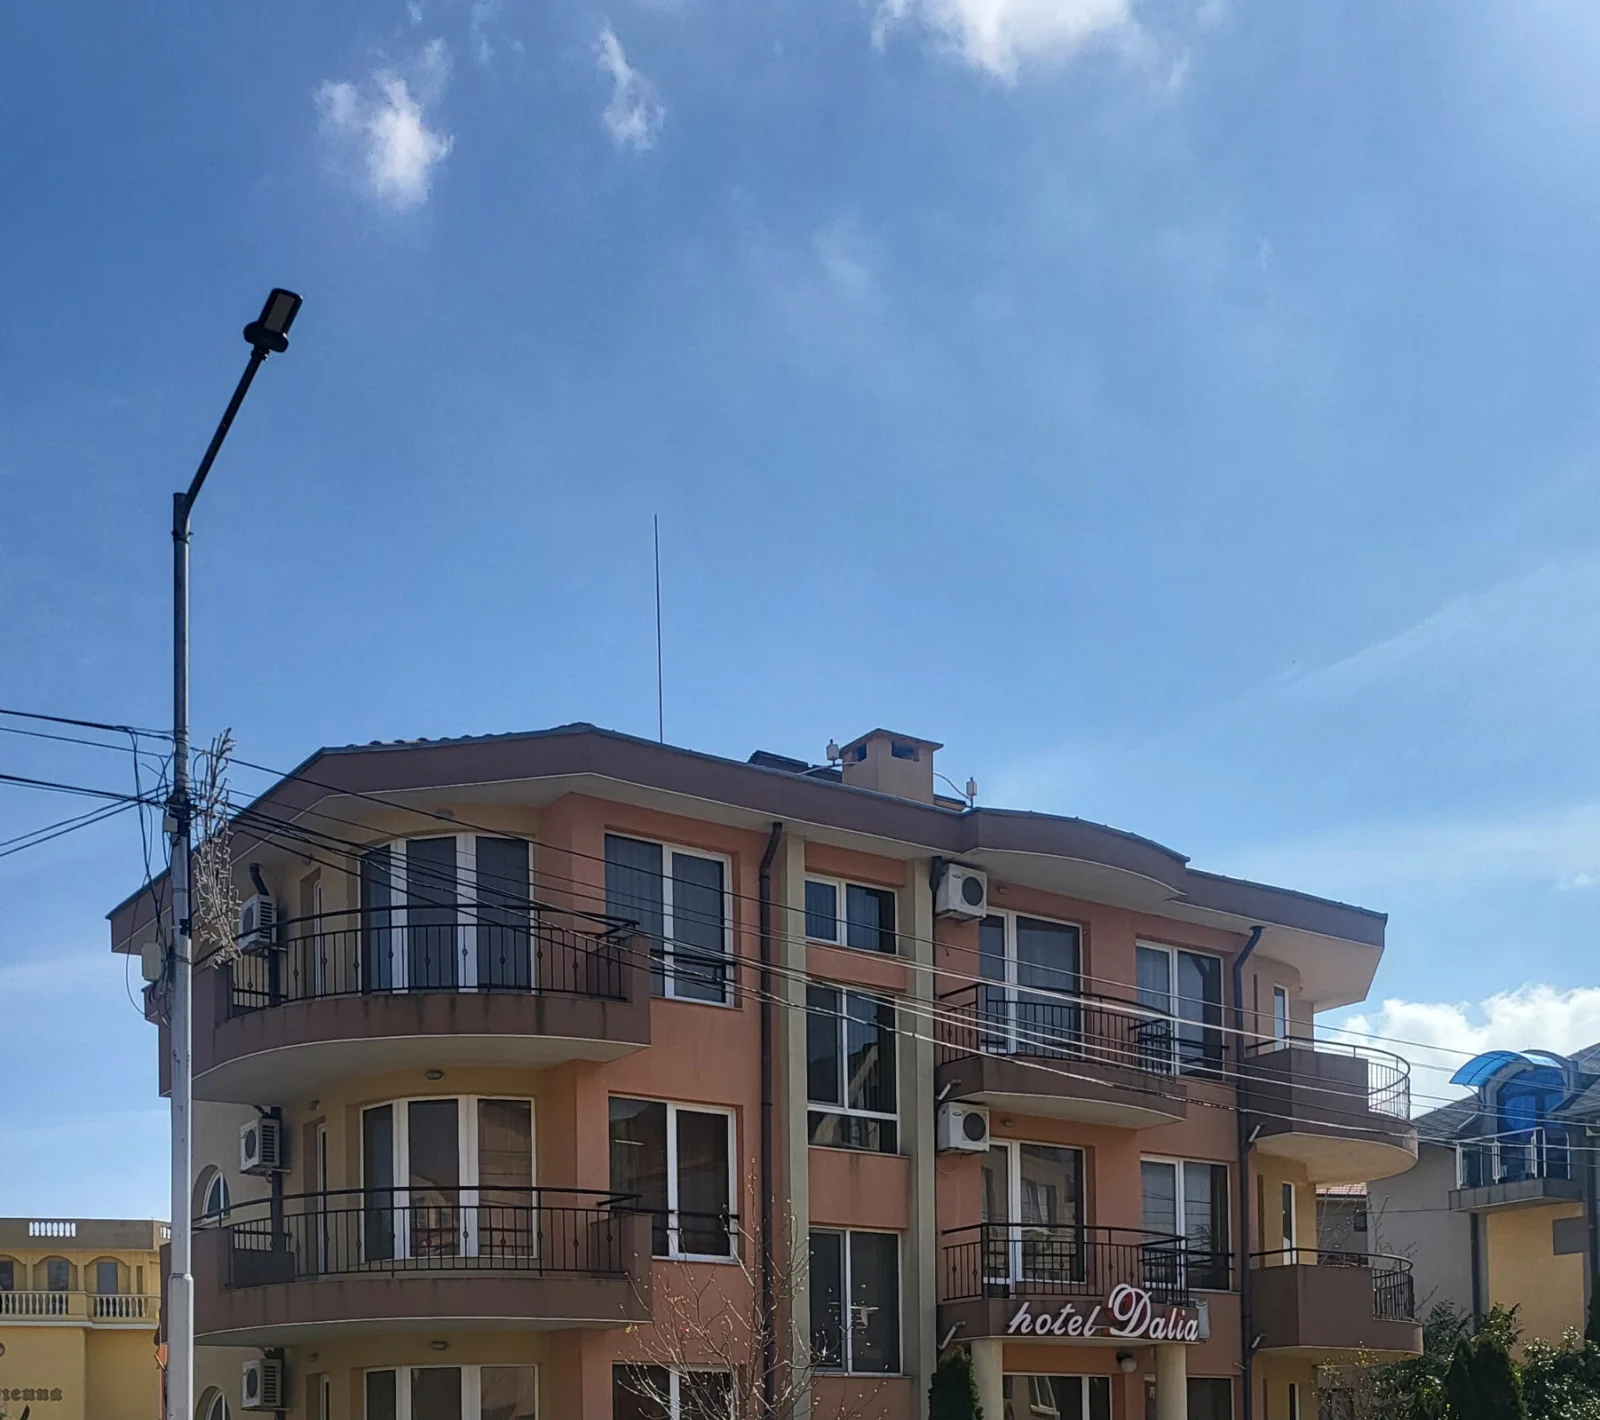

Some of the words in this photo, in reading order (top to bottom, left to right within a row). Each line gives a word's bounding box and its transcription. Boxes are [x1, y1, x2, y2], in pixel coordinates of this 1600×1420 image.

[1007, 1301, 1101, 1337] hotel
[1108, 1283, 1199, 1341] Dalia
[0, 1388, 63, 1401] ienna
